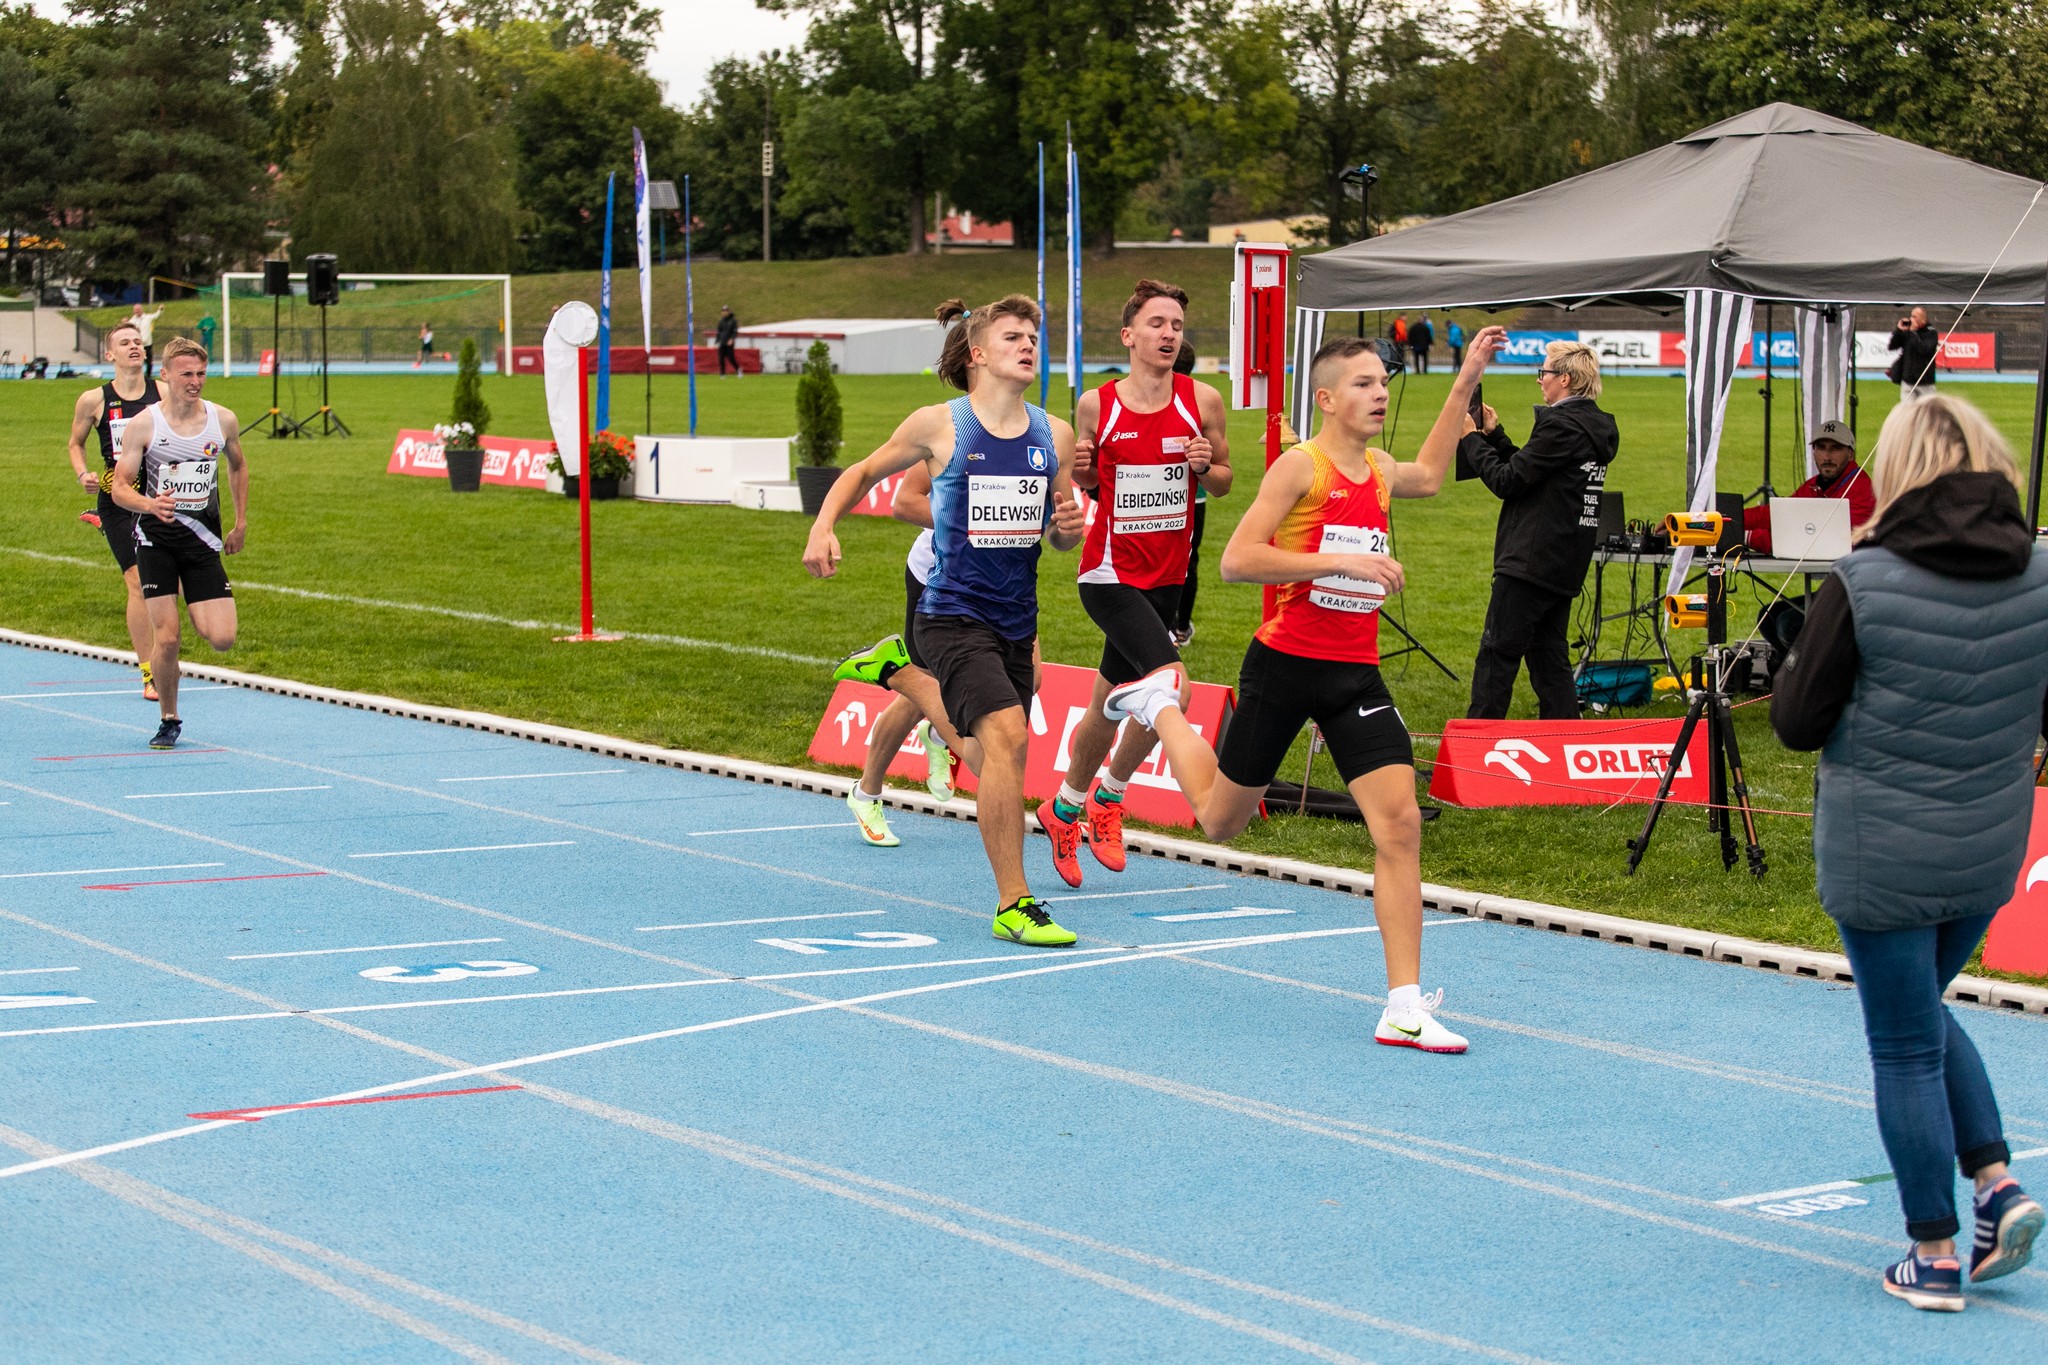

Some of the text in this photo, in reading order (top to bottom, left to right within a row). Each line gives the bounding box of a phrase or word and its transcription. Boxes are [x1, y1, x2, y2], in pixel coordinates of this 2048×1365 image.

[1946, 343, 1976, 355] ORLEN
[1120, 432, 1139, 440] asics
[483, 452, 505, 471] RLEN
[967, 452, 986, 460] esa
[195, 463, 210, 474] 48
[649, 442, 659, 495] 1
[1126, 471, 1151, 479] Kraków
[1164, 465, 1184, 481] 30
[1588, 466, 1606, 481] FUE
[162, 479, 210, 494] ŚWITOŃ
[1018, 479, 1038, 495] 36
[758, 489, 765, 508] 3
[1116, 488, 1188, 509] LEBIEDZIŃSKI
[1583, 494, 1599, 504] FUEL
[972, 505, 1041, 521] DELEWSKI
[1583, 506, 1595, 515] THE
[1122, 519, 1184, 532] KRAKÓW 2022
[977, 535, 1036, 546] KRAKÓW 2022
[1337, 535, 1361, 544] Kraków
[1319, 595, 1377, 612] KRAKÓW 2022
[752, 931, 940, 955] 2
[357, 960, 540, 984] 3
